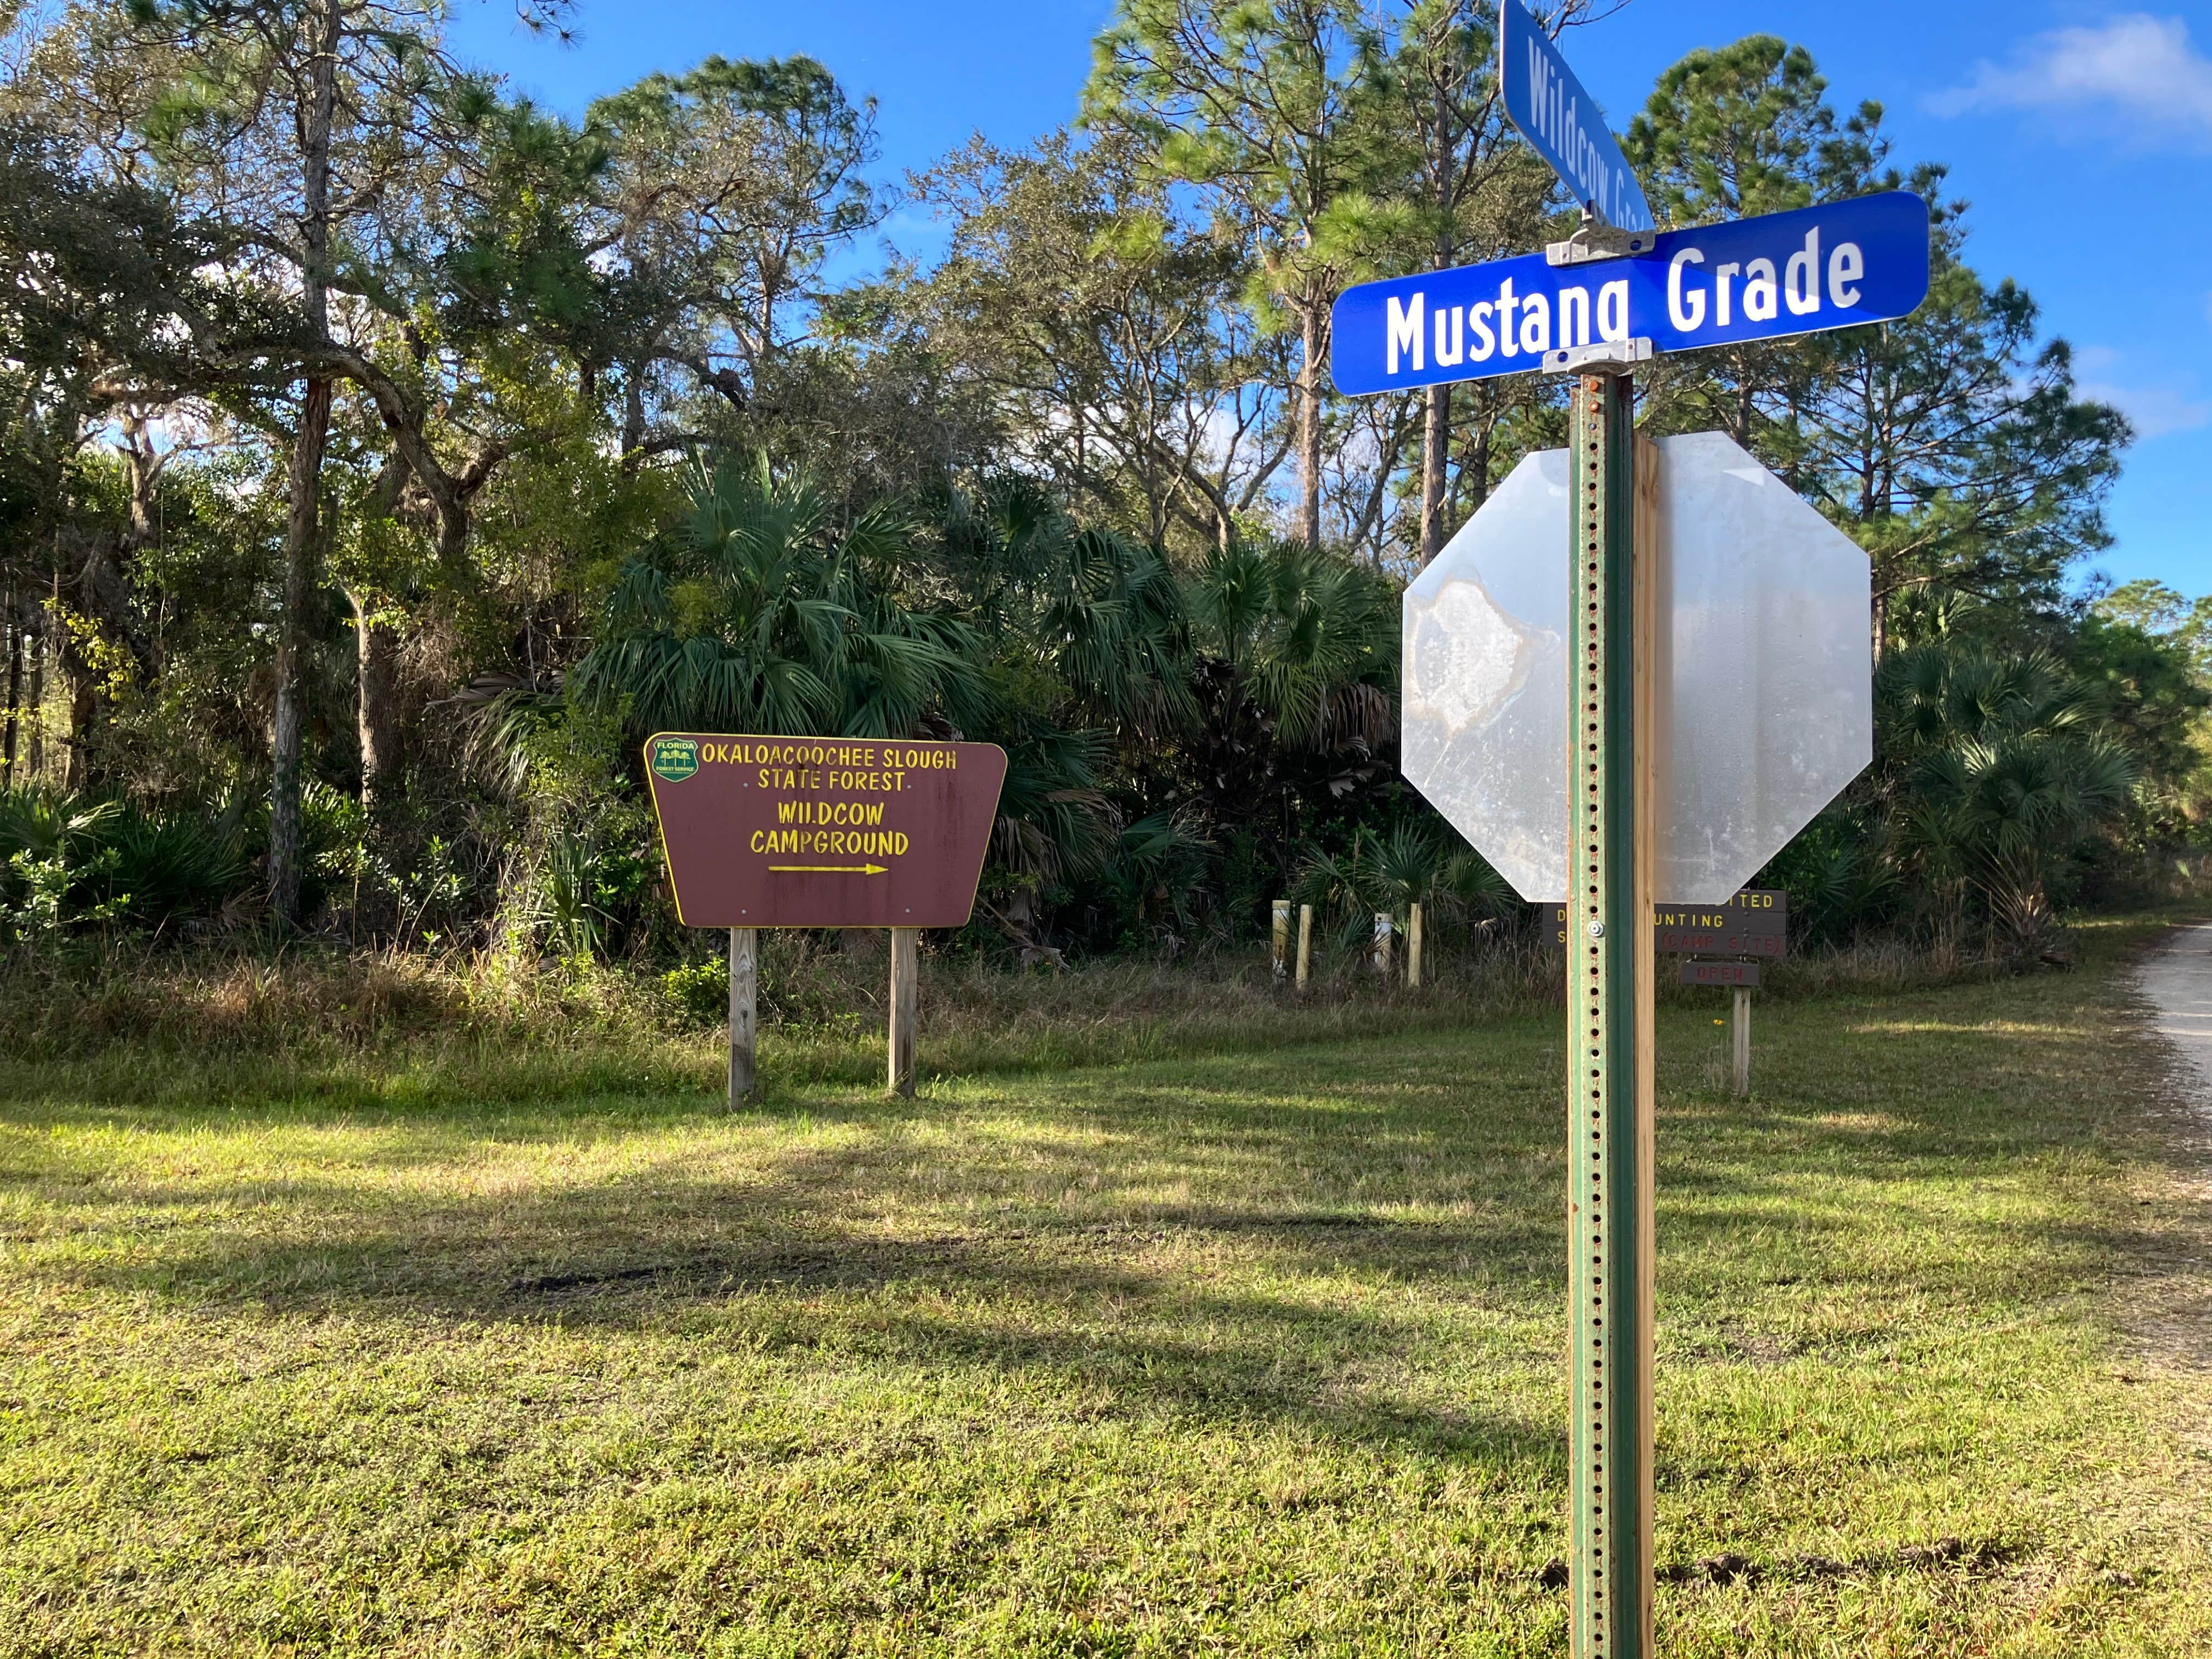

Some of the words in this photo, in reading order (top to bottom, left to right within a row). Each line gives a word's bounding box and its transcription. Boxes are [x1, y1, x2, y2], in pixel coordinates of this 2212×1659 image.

[1528, 35, 1609, 221] Wildcow
[1386, 276, 1629, 375] Mustang
[1668, 225, 1864, 332] Grade
[702, 743, 874, 766] OKALOACOOCHEE
[882, 749, 956, 769] SLOUGH
[758, 769, 821, 789] STATE
[829, 771, 905, 791] FOREST
[778, 801, 884, 825] WILDCOW
[750, 830, 909, 856] CAMPGROUND
[1654, 913, 1723, 927] UNTING
[1697, 967, 1743, 981] OPEN
